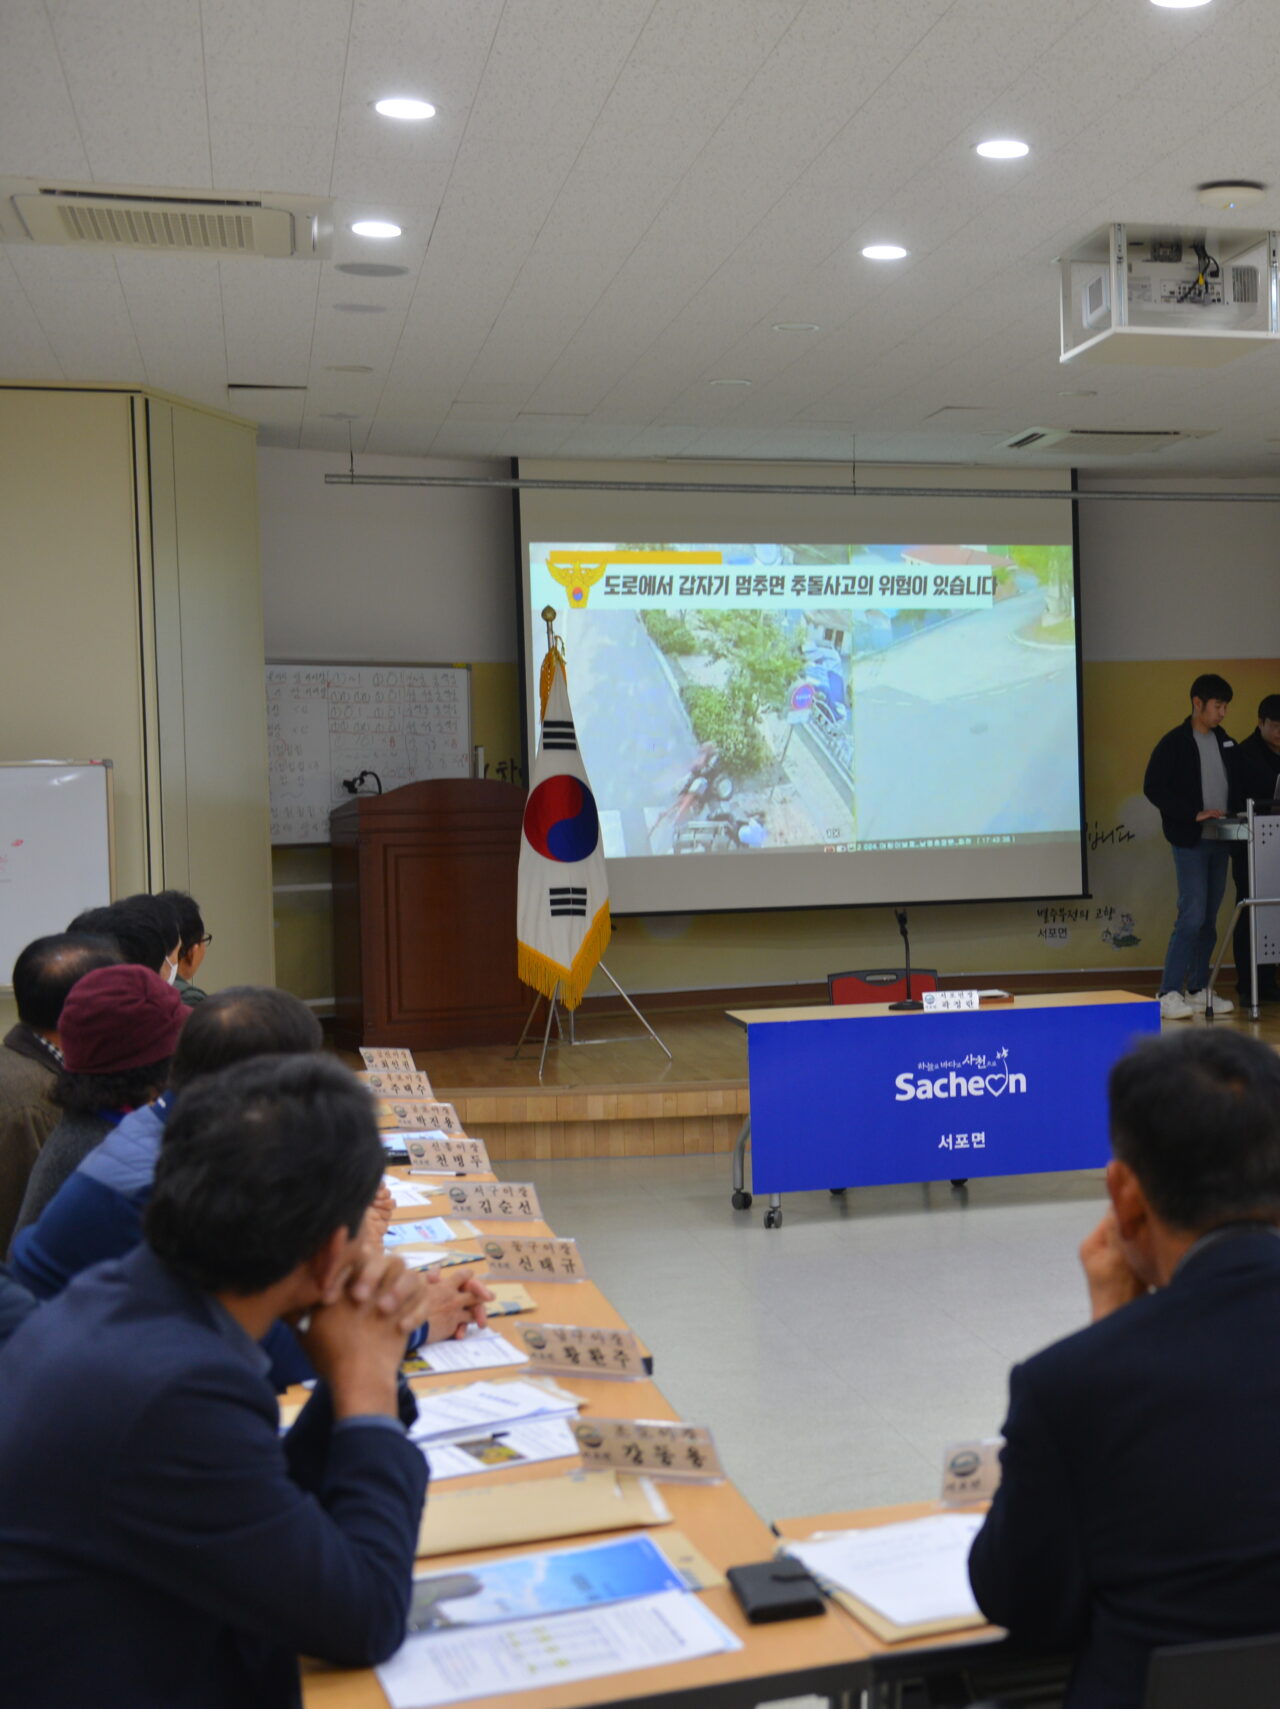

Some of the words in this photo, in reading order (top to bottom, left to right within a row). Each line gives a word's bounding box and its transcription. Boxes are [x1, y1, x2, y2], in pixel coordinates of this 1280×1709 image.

[603, 574, 674, 597] 도로에서
[678, 574, 731, 597] 갑자기
[735, 574, 786, 597] 멈추면
[790, 574, 874, 597] 추돌사고의
[878, 574, 928, 597] 위험이
[932, 574, 997, 597] 있습니다
[1036, 906, 1089, 923] 별주부전의
[1095, 905, 1116, 921] 고향
[1037, 927, 1068, 940] 서포면
[938, 1131, 986, 1150] 서포면
[479, 1199, 534, 1215] 김순선
